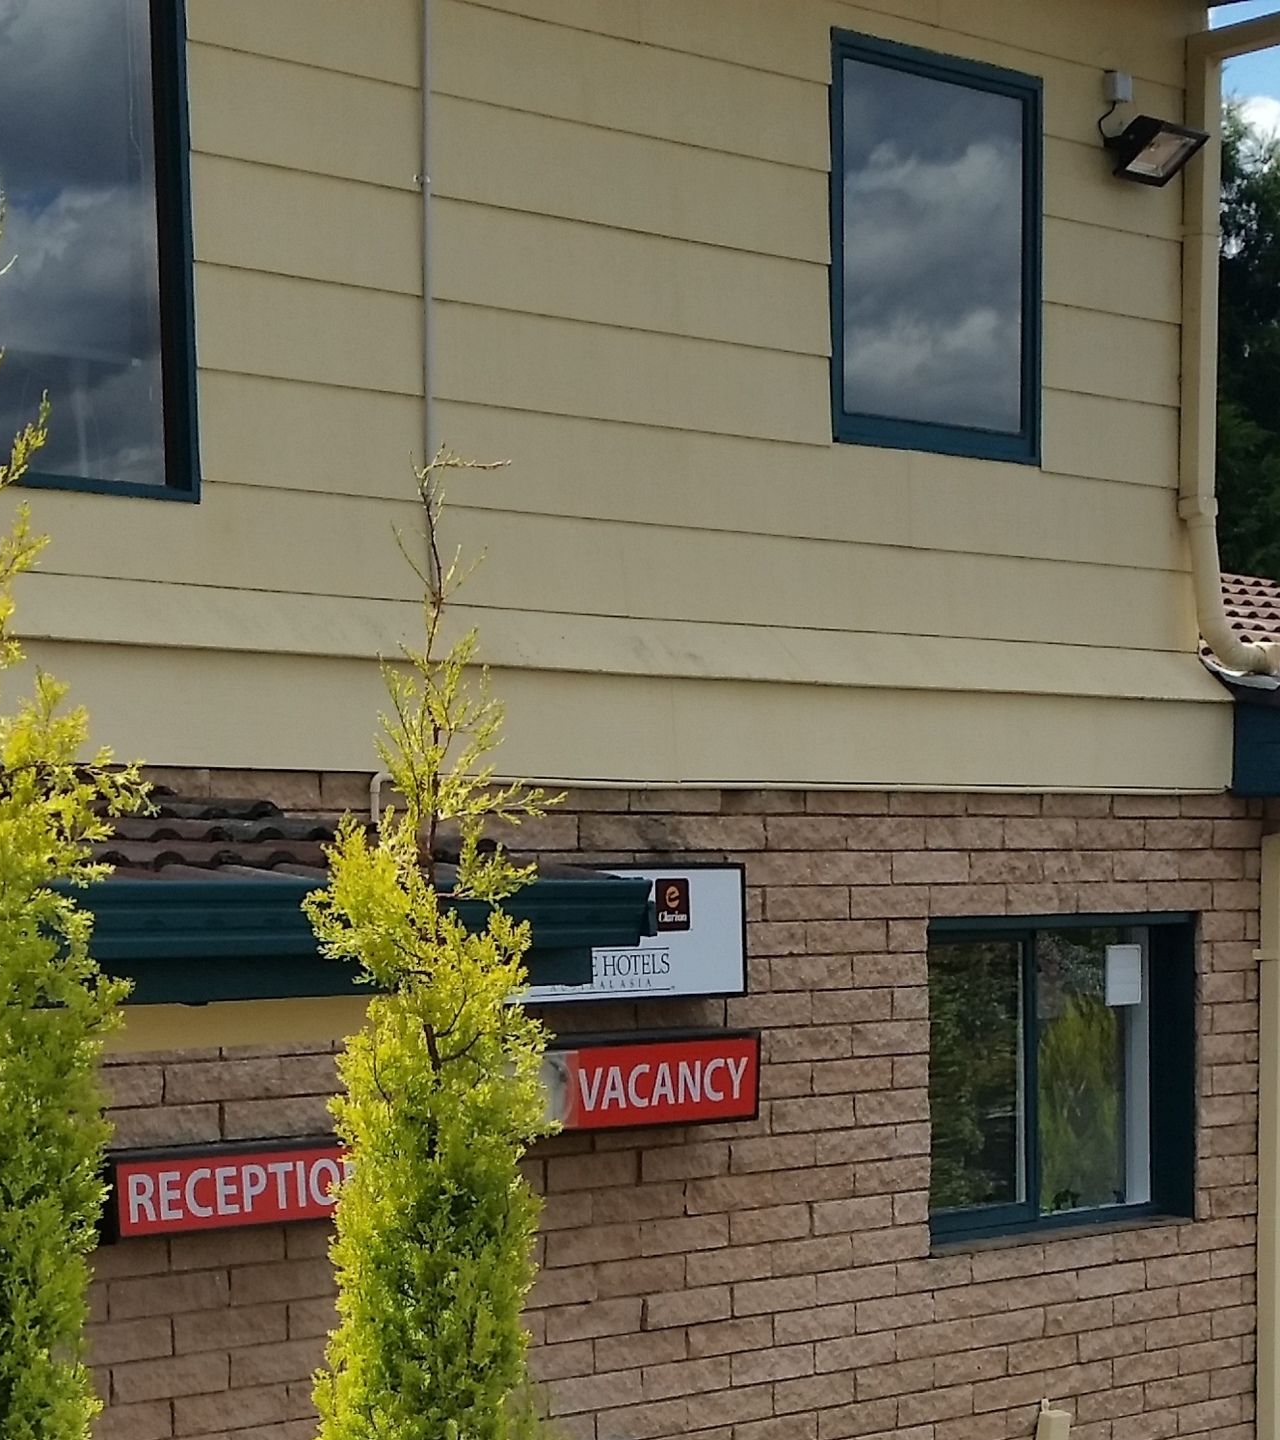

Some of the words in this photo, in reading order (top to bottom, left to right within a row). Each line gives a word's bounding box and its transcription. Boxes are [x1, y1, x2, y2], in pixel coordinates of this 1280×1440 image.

[602, 953, 670, 977] HOTELS
[578, 1057, 749, 1111] VACANCY
[128, 1158, 357, 1224] RECEPTIO
